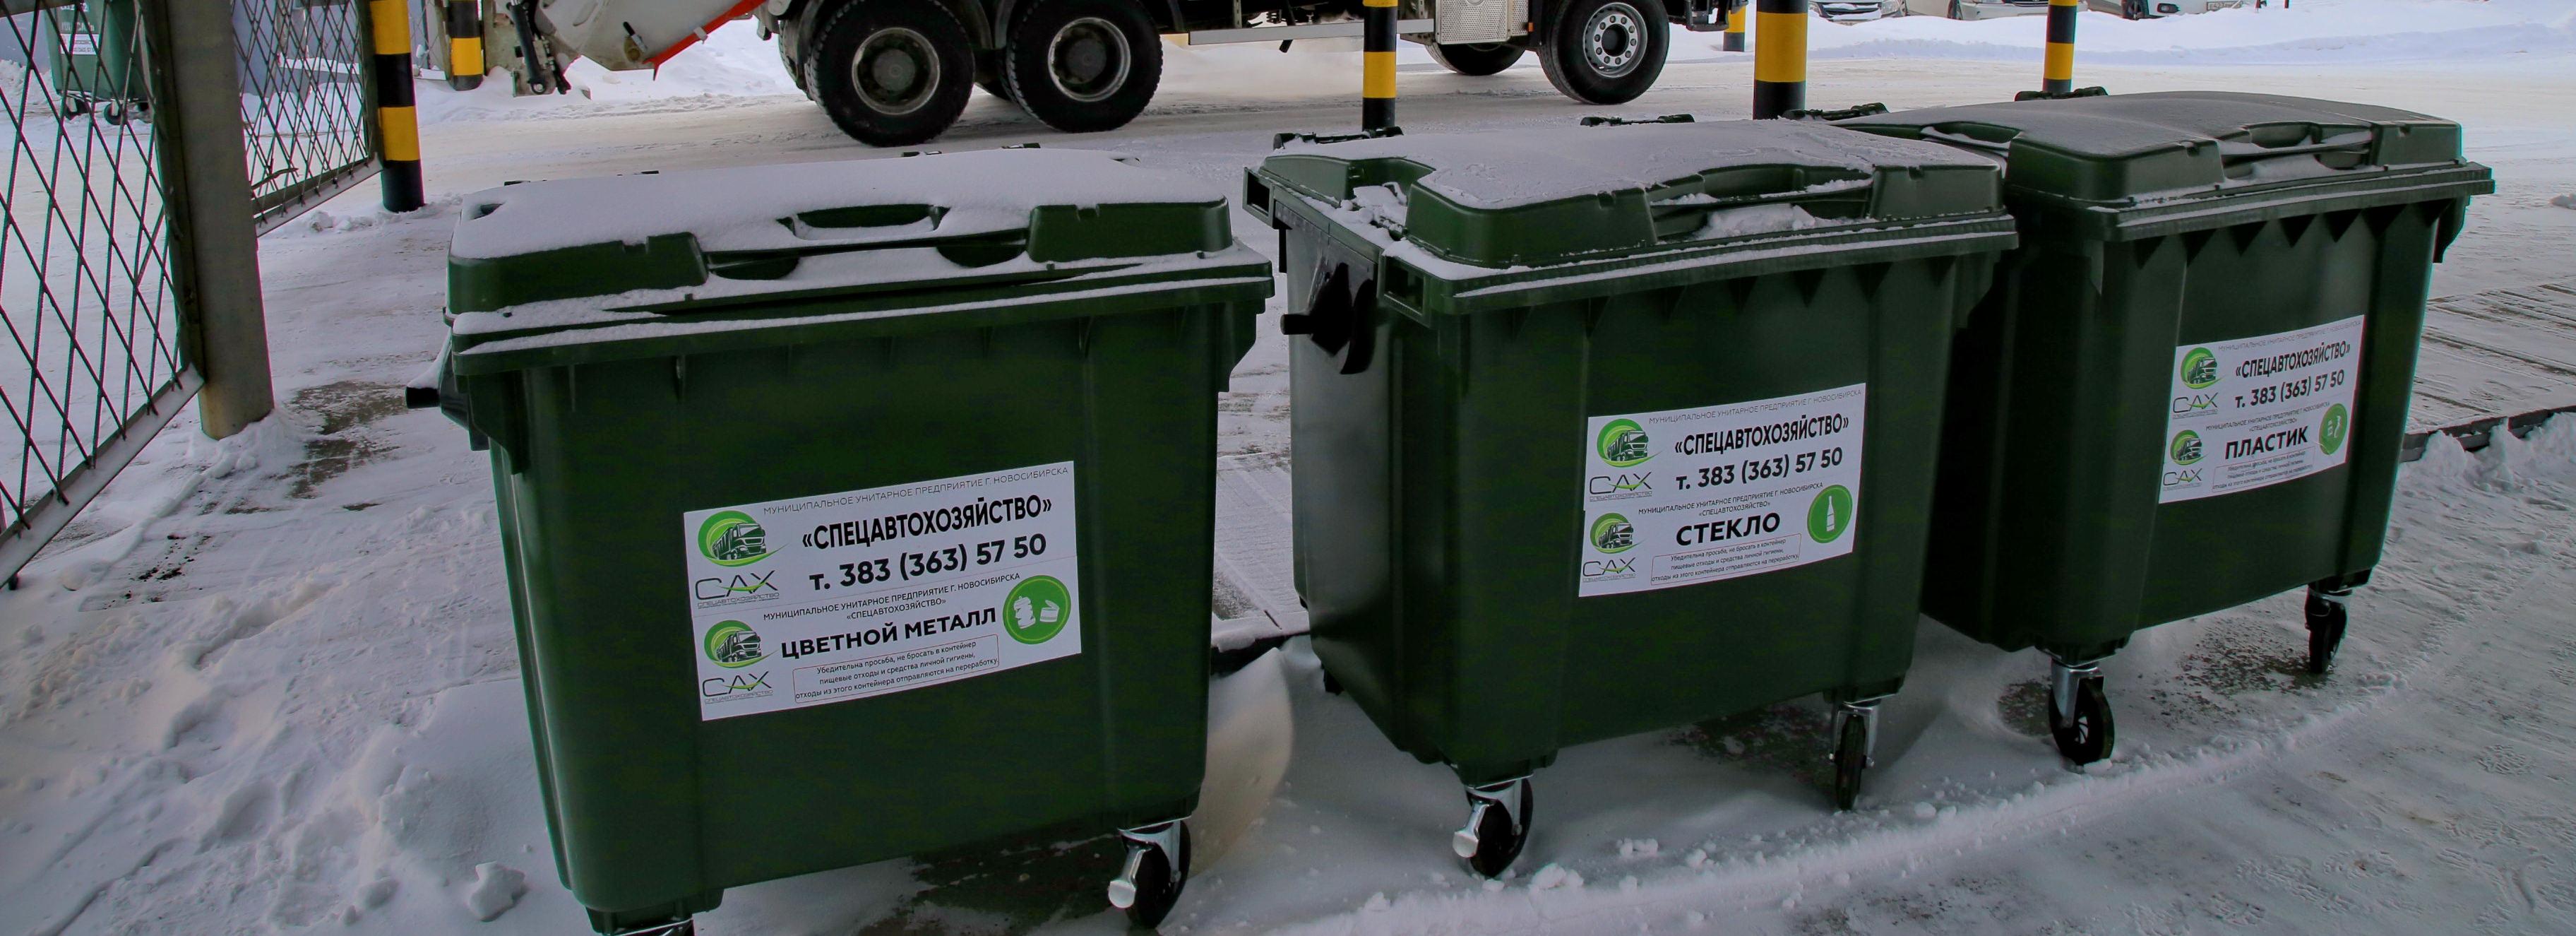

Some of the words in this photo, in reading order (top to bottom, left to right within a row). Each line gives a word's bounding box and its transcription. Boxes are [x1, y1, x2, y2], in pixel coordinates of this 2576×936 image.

[2235, 340, 2351, 378] «СПЕЦАВТОХОЗЯЙСТВО»
[2173, 392, 2218, 413] САХ
[2235, 396, 2246, 408] т.
[2250, 386, 2277, 406] 383
[2280, 376, 2311, 402] (363)
[2315, 374, 2328, 392] 57
[2330, 369, 2344, 388] 50
[1649, 411, 1716, 424] МУНИЦИПАЛЬНОЕ
[1717, 405, 1758, 417] УНИТАРНОЕ
[1760, 398, 1807, 413] ПРЕДПРИЯТИЕ
[1813, 389, 1861, 403] НОВОСИБИРСКА
[1675, 413, 1849, 455] «СПЕЦАВТОХОЗЯЙСТВО»
[2225, 425, 2308, 460] ПЛАСТИК
[1590, 471, 1652, 495] САХ
[1676, 475, 1690, 490] т.
[1698, 464, 1735, 487] 383
[1741, 454, 1789, 484] (363)
[1795, 451, 1816, 473] 57
[1820, 446, 1842, 468] 50
[2163, 468, 2202, 486] САХ
[763, 496, 853, 515] МУНИЦИПАЛЬНОЕ
[856, 488, 912, 502] УНИТАРНОЕ
[915, 478, 982, 494] ПРЕДПРИЯТИЕ
[994, 467, 1068, 484] НОВОСИБИРСКА
[1638, 502, 1695, 514] МУНИЦИПАЛЬНОЕ
[1696, 497, 1731, 508] УНИТАРНОЕ
[1732, 490, 1774, 503] ПРЕДПРИЯТИЕ
[1779, 482, 1823, 494] НОВОСИБИРСКА
[802, 494, 1052, 550] «СПЕЦАВТОХОЗЯЙСТВО»
[1698, 501, 1770, 516] «СПЕЦАВТОХОЗЯЙСТВО»
[1676, 512, 1780, 546] СТЕКЛО
[809, 573, 830, 591] т.
[839, 558, 890, 587] 383
[900, 543, 967, 581] (363)
[977, 539, 1005, 565] 57
[1014, 533, 1046, 559] 50
[1582, 557, 1635, 576] САХ
[1671, 552, 1705, 562] Убедительна
[1736, 543, 1756, 552] бросать
[1761, 538, 1787, 548] контейнер
[1671, 562, 1695, 570] пищевые
[1720, 555, 1743, 564] средства
[1743, 550, 1763, 559] личной
[695, 569, 778, 600] САХ
[1695, 566, 1724, 576] контейнера
[1725, 561, 1760, 571] отправляются
[763, 604, 839, 620] МУНИЦИПАЛЬНОЕ
[841, 596, 890, 610] УНИТАРНОЕ
[891, 586, 949, 602] ПРЕДПРИЯТИЕ
[958, 572, 1020, 591] НОВОСИБИРСКА
[847, 598, 946, 620] «СПЕЦАВТОХОЗЯЙСТВО»
[781, 622, 898, 660] ЦВЕТНОЙ
[905, 608, 996, 639] МЕТАЛЛ
[816, 662, 863, 674] Убедительна
[864, 654, 895, 668] просьба,
[906, 651, 934, 660] бросать
[941, 641, 977, 653] контейнер
[819, 675, 852, 685] пищевые
[853, 670, 879, 680] отходы
[887, 663, 919, 675] средства
[919, 657, 945, 668] личной
[946, 651, 975, 663] гигиены,
[702, 670, 772, 697] САХ
[795, 689, 822, 699] отходы
[833, 685, 852, 693] этого
[854, 678, 895, 690] контейнера
[896, 669, 944, 682] отправляются
[955, 658, 999, 673] переработку.
